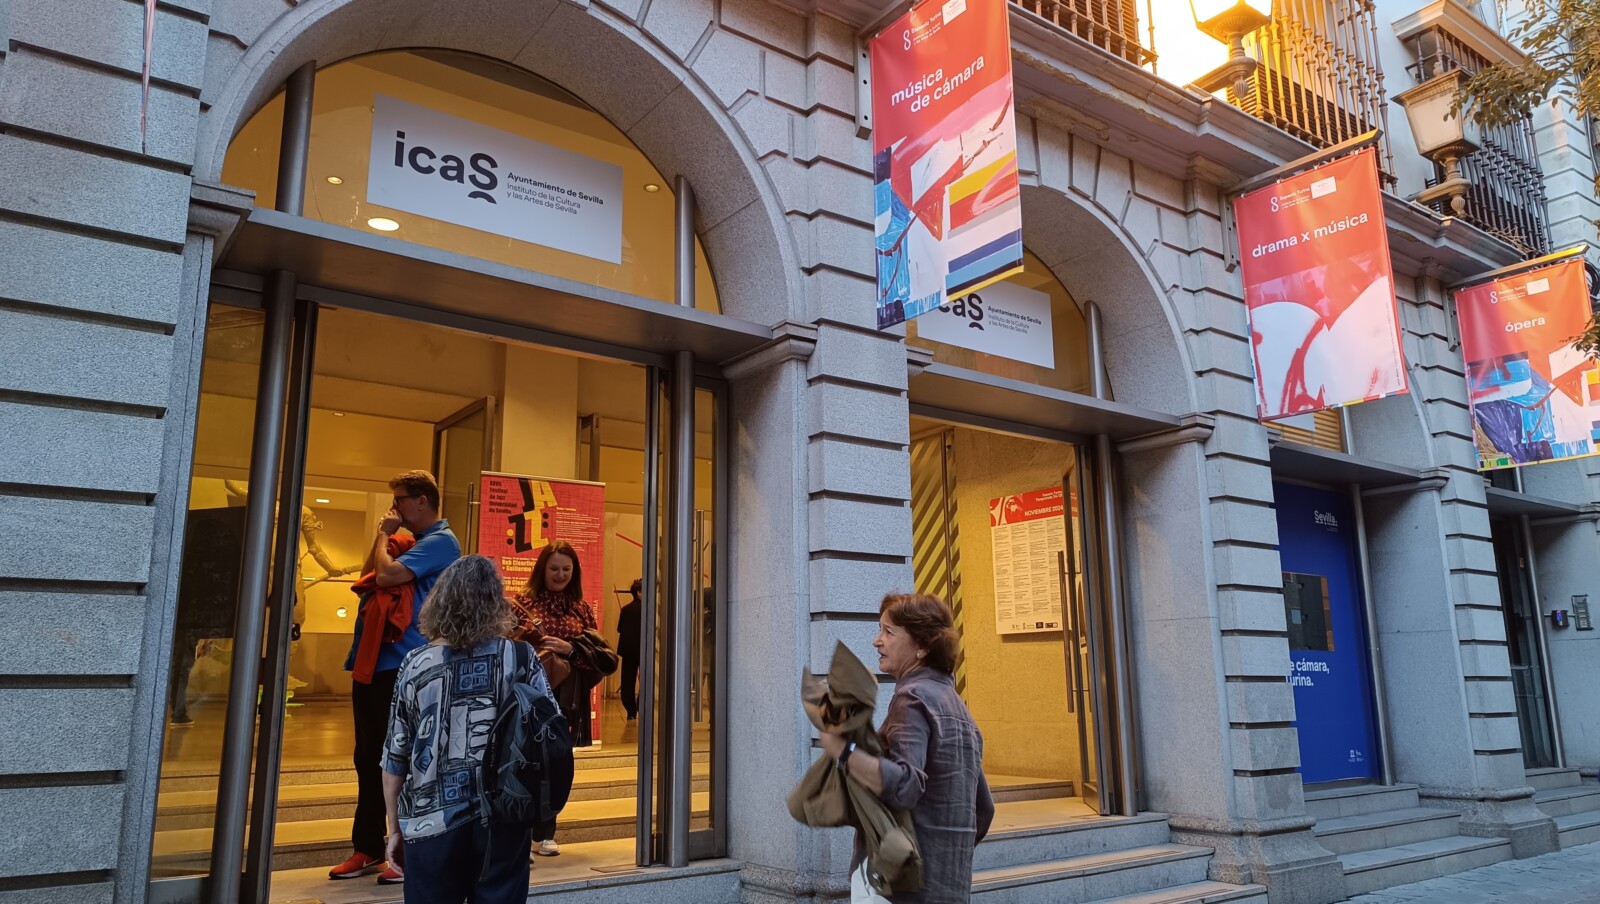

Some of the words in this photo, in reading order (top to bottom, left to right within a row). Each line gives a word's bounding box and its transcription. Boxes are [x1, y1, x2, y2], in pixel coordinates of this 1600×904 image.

[891, 68, 943, 106] música
[910, 94, 930, 113] de
[934, 56, 984, 100] cámara
[506, 182, 537, 196] Instituto
[538, 191, 548, 200] de
[556, 196, 581, 209] Cultura
[508, 172, 566, 194] Ayuntamiento
[566, 188, 578, 198] de
[578, 191, 604, 205] Sevilla
[512, 192, 523, 200] las
[524, 195, 544, 206] Artes
[544, 200, 554, 209] de
[555, 202, 578, 215] Sevilla
[1252, 235, 1298, 258] drama
[1301, 232, 1310, 242] x
[1314, 212, 1368, 239] música
[1504, 317, 1546, 333] ópera
[1024, 506, 1051, 516] NOVIEMBRE
[1296, 658, 1330, 674] cámara,
